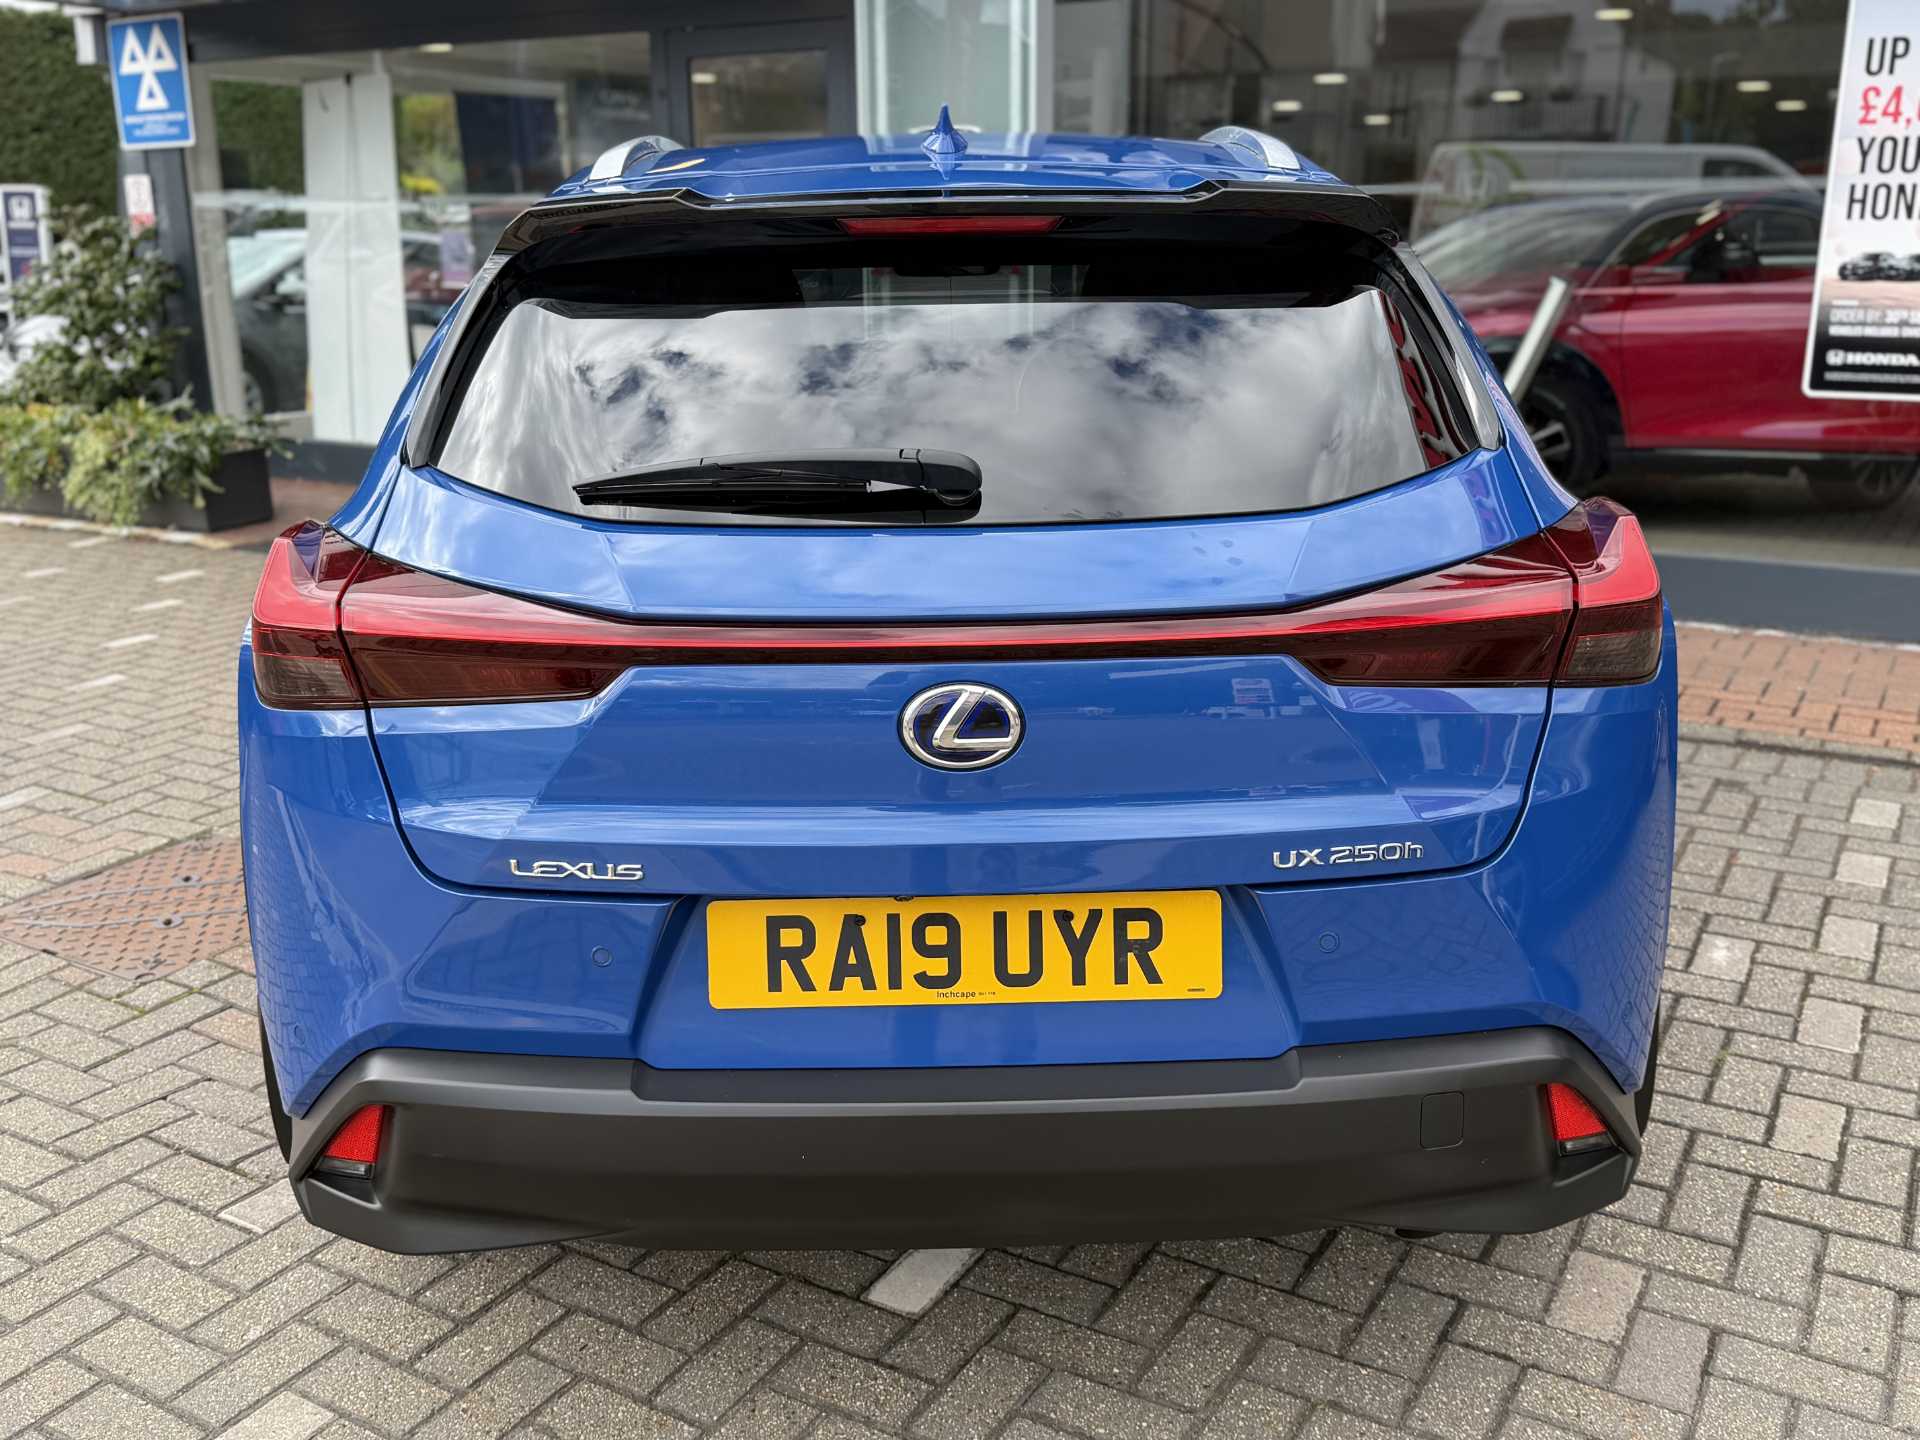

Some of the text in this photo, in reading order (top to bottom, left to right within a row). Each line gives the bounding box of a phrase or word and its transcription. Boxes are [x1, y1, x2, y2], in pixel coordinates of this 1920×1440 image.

[1865, 37, 1911, 76] UP
[1857, 85, 1920, 129] £4,
[1846, 183, 1920, 220] HON
[1846, 351, 1920, 367] HONDA
[509, 859, 644, 881] LEXUS
[1272, 841, 1424, 869] UX 250h
[766, 907, 1164, 993] RA19 UYR
[936, 990, 976, 999] Inchcape
